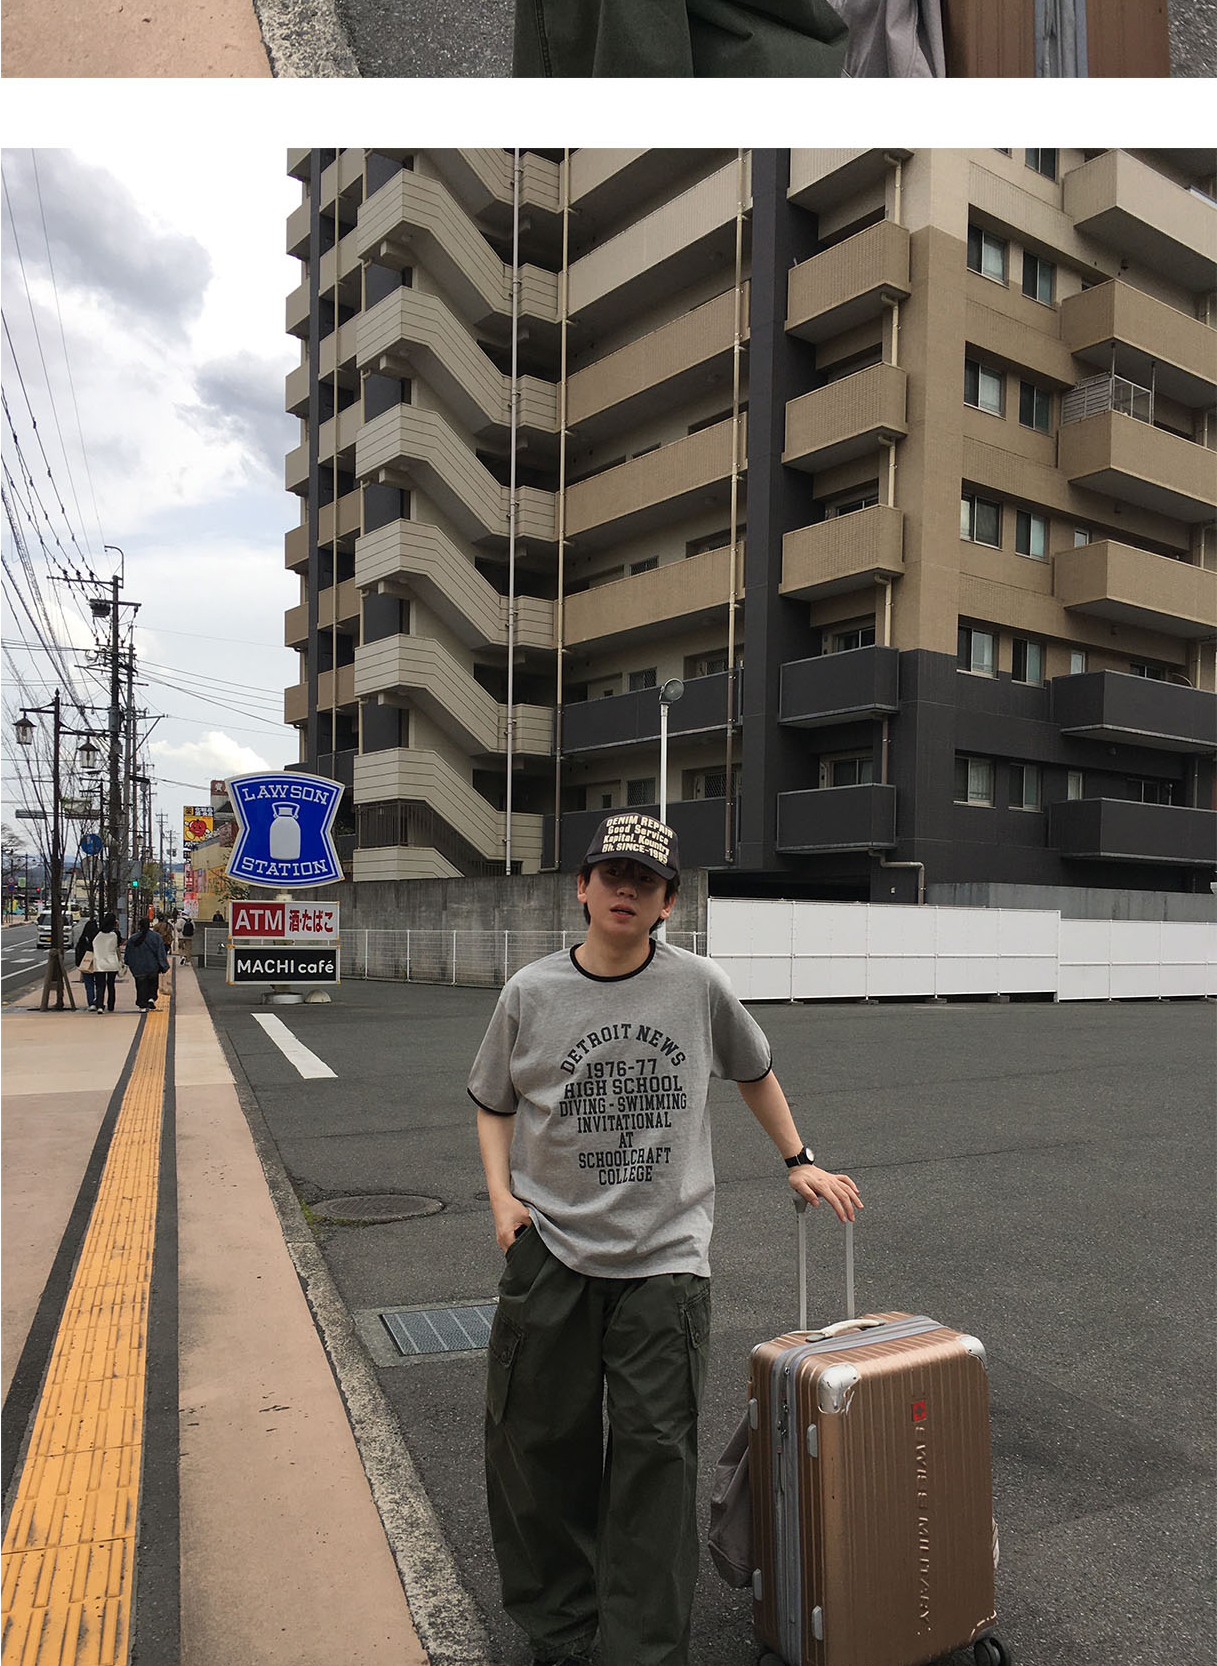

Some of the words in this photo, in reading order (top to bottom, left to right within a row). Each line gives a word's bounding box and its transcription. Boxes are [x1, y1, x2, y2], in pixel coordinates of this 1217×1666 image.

[242, 785, 330, 805] LAWSON
[606, 815, 638, 827] DENIM
[640, 816, 673, 839] REPAIR
[608, 825, 630, 835] Good
[634, 824, 668, 845] Service
[638, 835, 670, 856] Kountry
[241, 857, 328, 877] STATION
[235, 909, 282, 931] ATM
[289, 909, 334, 933] 酒・たばこ
[237, 959, 294, 974] MACHI
[298, 959, 334, 974] café
[560, 1023, 632, 1075] DETROIT
[636, 1025, 686, 1067] NEWS
[586, 1059, 658, 1079] 1976-77
[564, 1079, 608, 1099] HIGH
[612, 1075, 683, 1095] SCHOOL
[559, 1098, 606, 1117] DIVING
[617, 1093, 687, 1113] SWIMMING
[577, 1111, 672, 1133] INVITATIONAL
[618, 1132, 634, 1149] AT
[578, 1147, 672, 1169] SCHOOLCRAFT
[599, 1165, 653, 1185] COLLEGE
